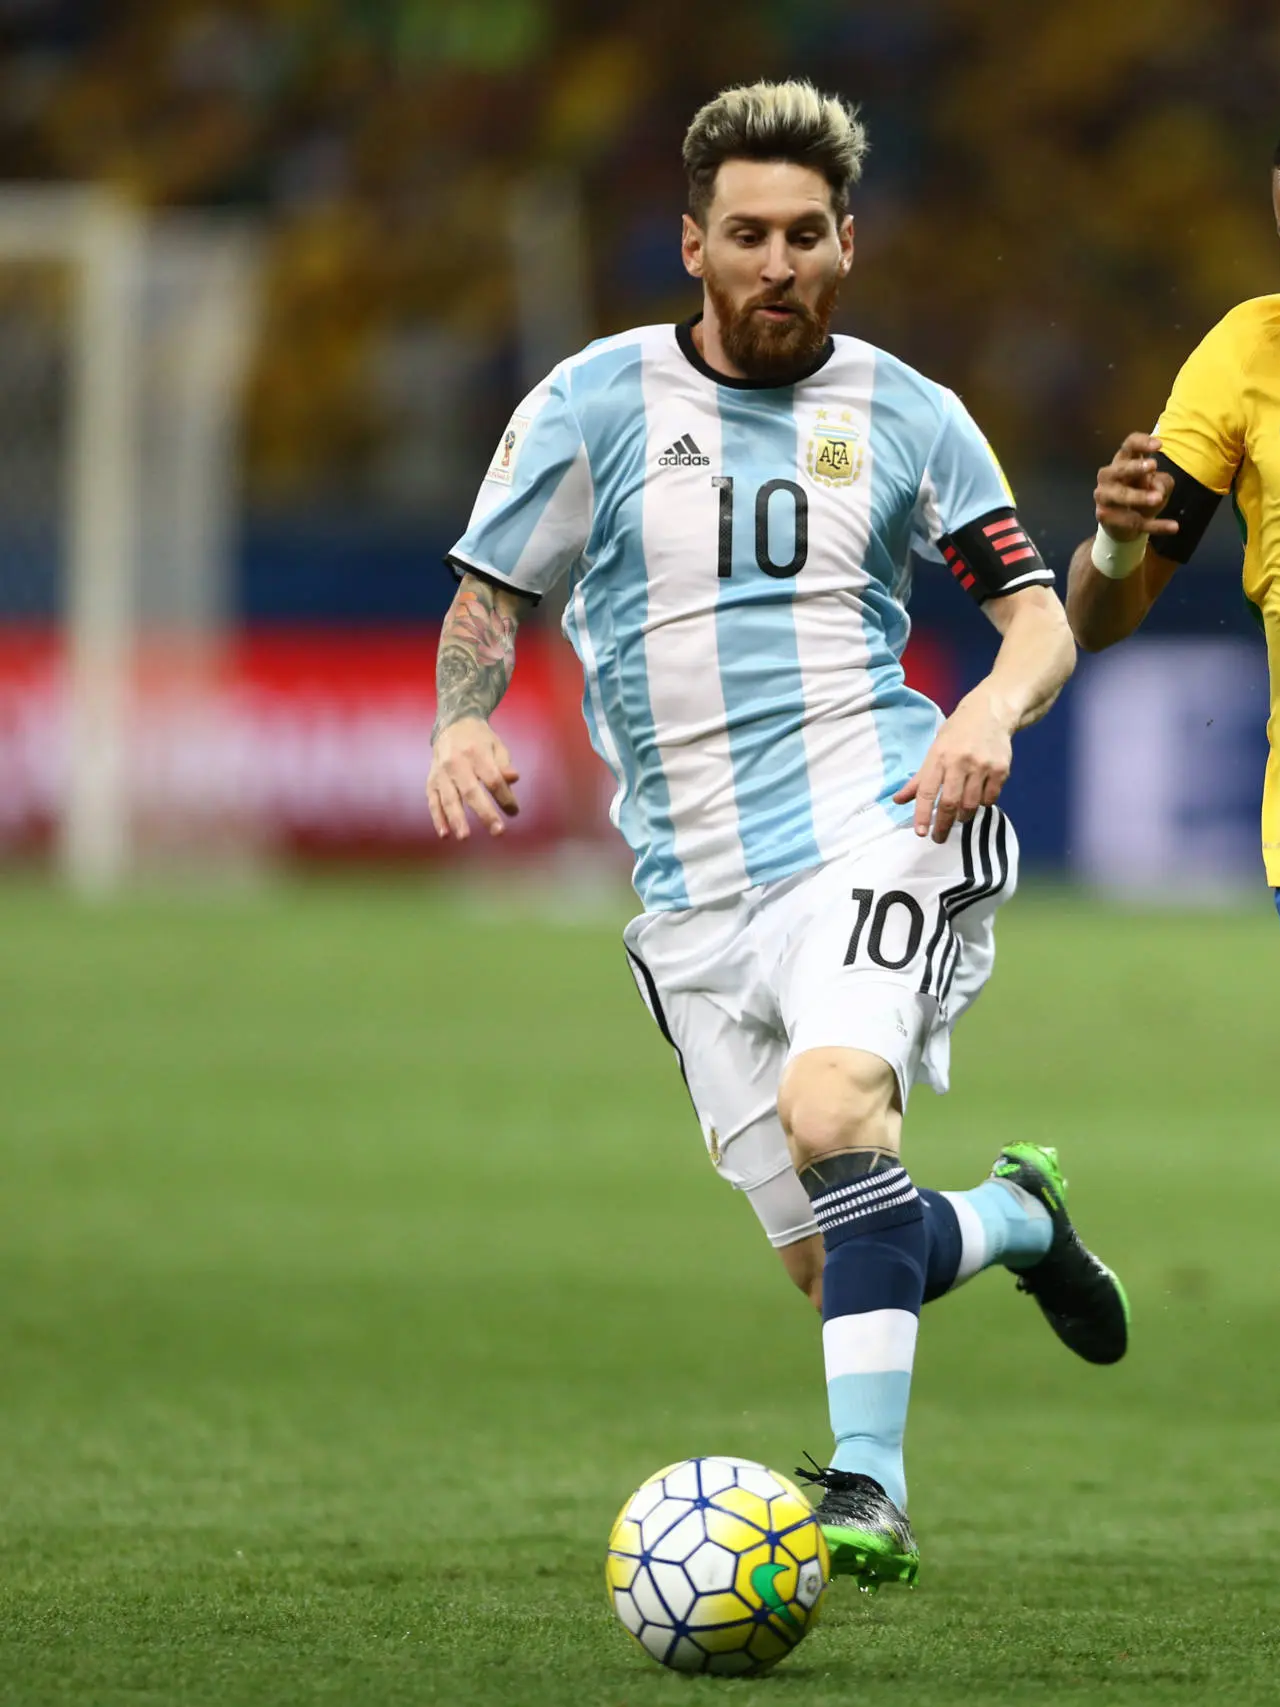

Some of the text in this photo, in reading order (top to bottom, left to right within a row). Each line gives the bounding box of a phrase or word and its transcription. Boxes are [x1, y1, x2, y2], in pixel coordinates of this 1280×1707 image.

[658, 454, 710, 466] adidas
[819, 440, 849, 470] AFA
[711, 476, 808, 579] 10
[843, 888, 924, 970] 10
